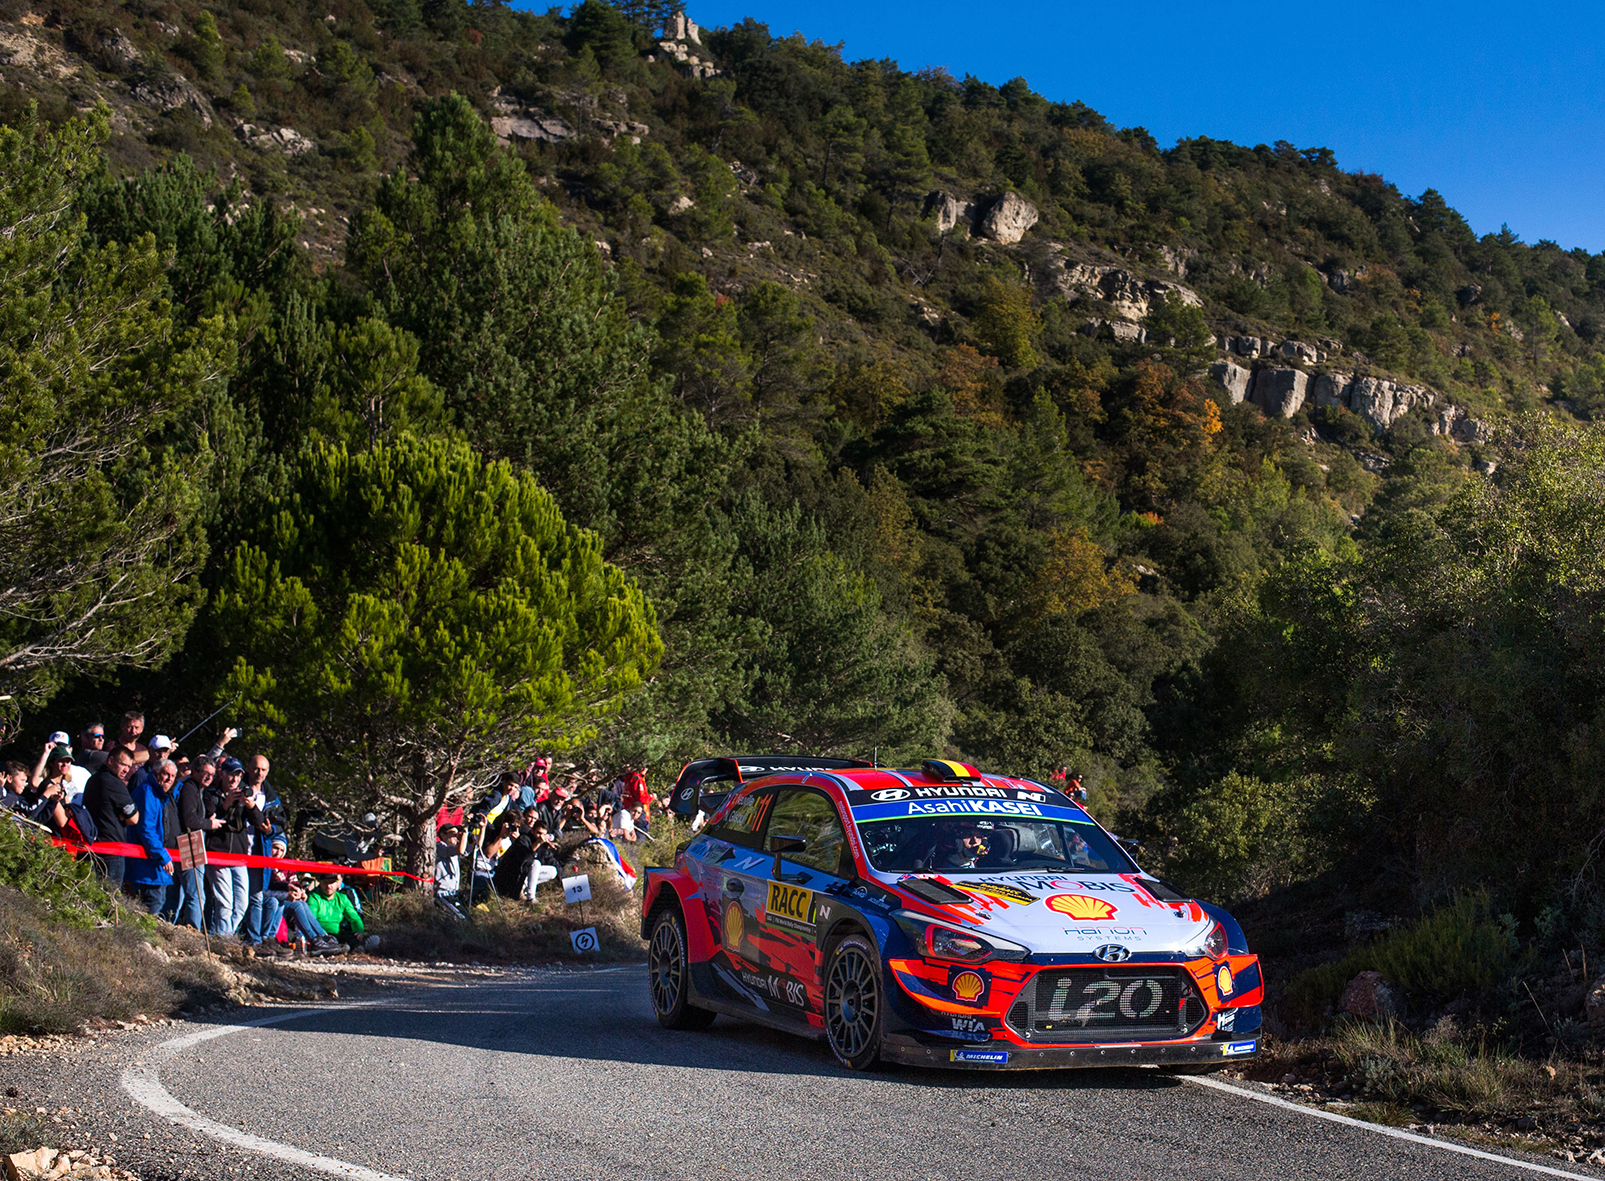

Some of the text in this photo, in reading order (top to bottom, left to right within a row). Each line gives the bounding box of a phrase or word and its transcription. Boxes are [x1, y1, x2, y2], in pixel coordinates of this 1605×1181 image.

[915, 786, 1007, 798] HYUNDAI
[752, 793, 774, 832] 11
[978, 875, 1068, 883] HYUNDAI
[1017, 880, 1136, 893] MOBIS
[572, 885, 583, 894] 13
[770, 884, 807, 919] RACC
[819, 904, 831, 920] N
[742, 971, 805, 1007] HYUNDAI MOBIS
[1048, 977, 1163, 1021] i20
[951, 1017, 986, 1033] WIA
[965, 1053, 1004, 1061] MICHELIN
